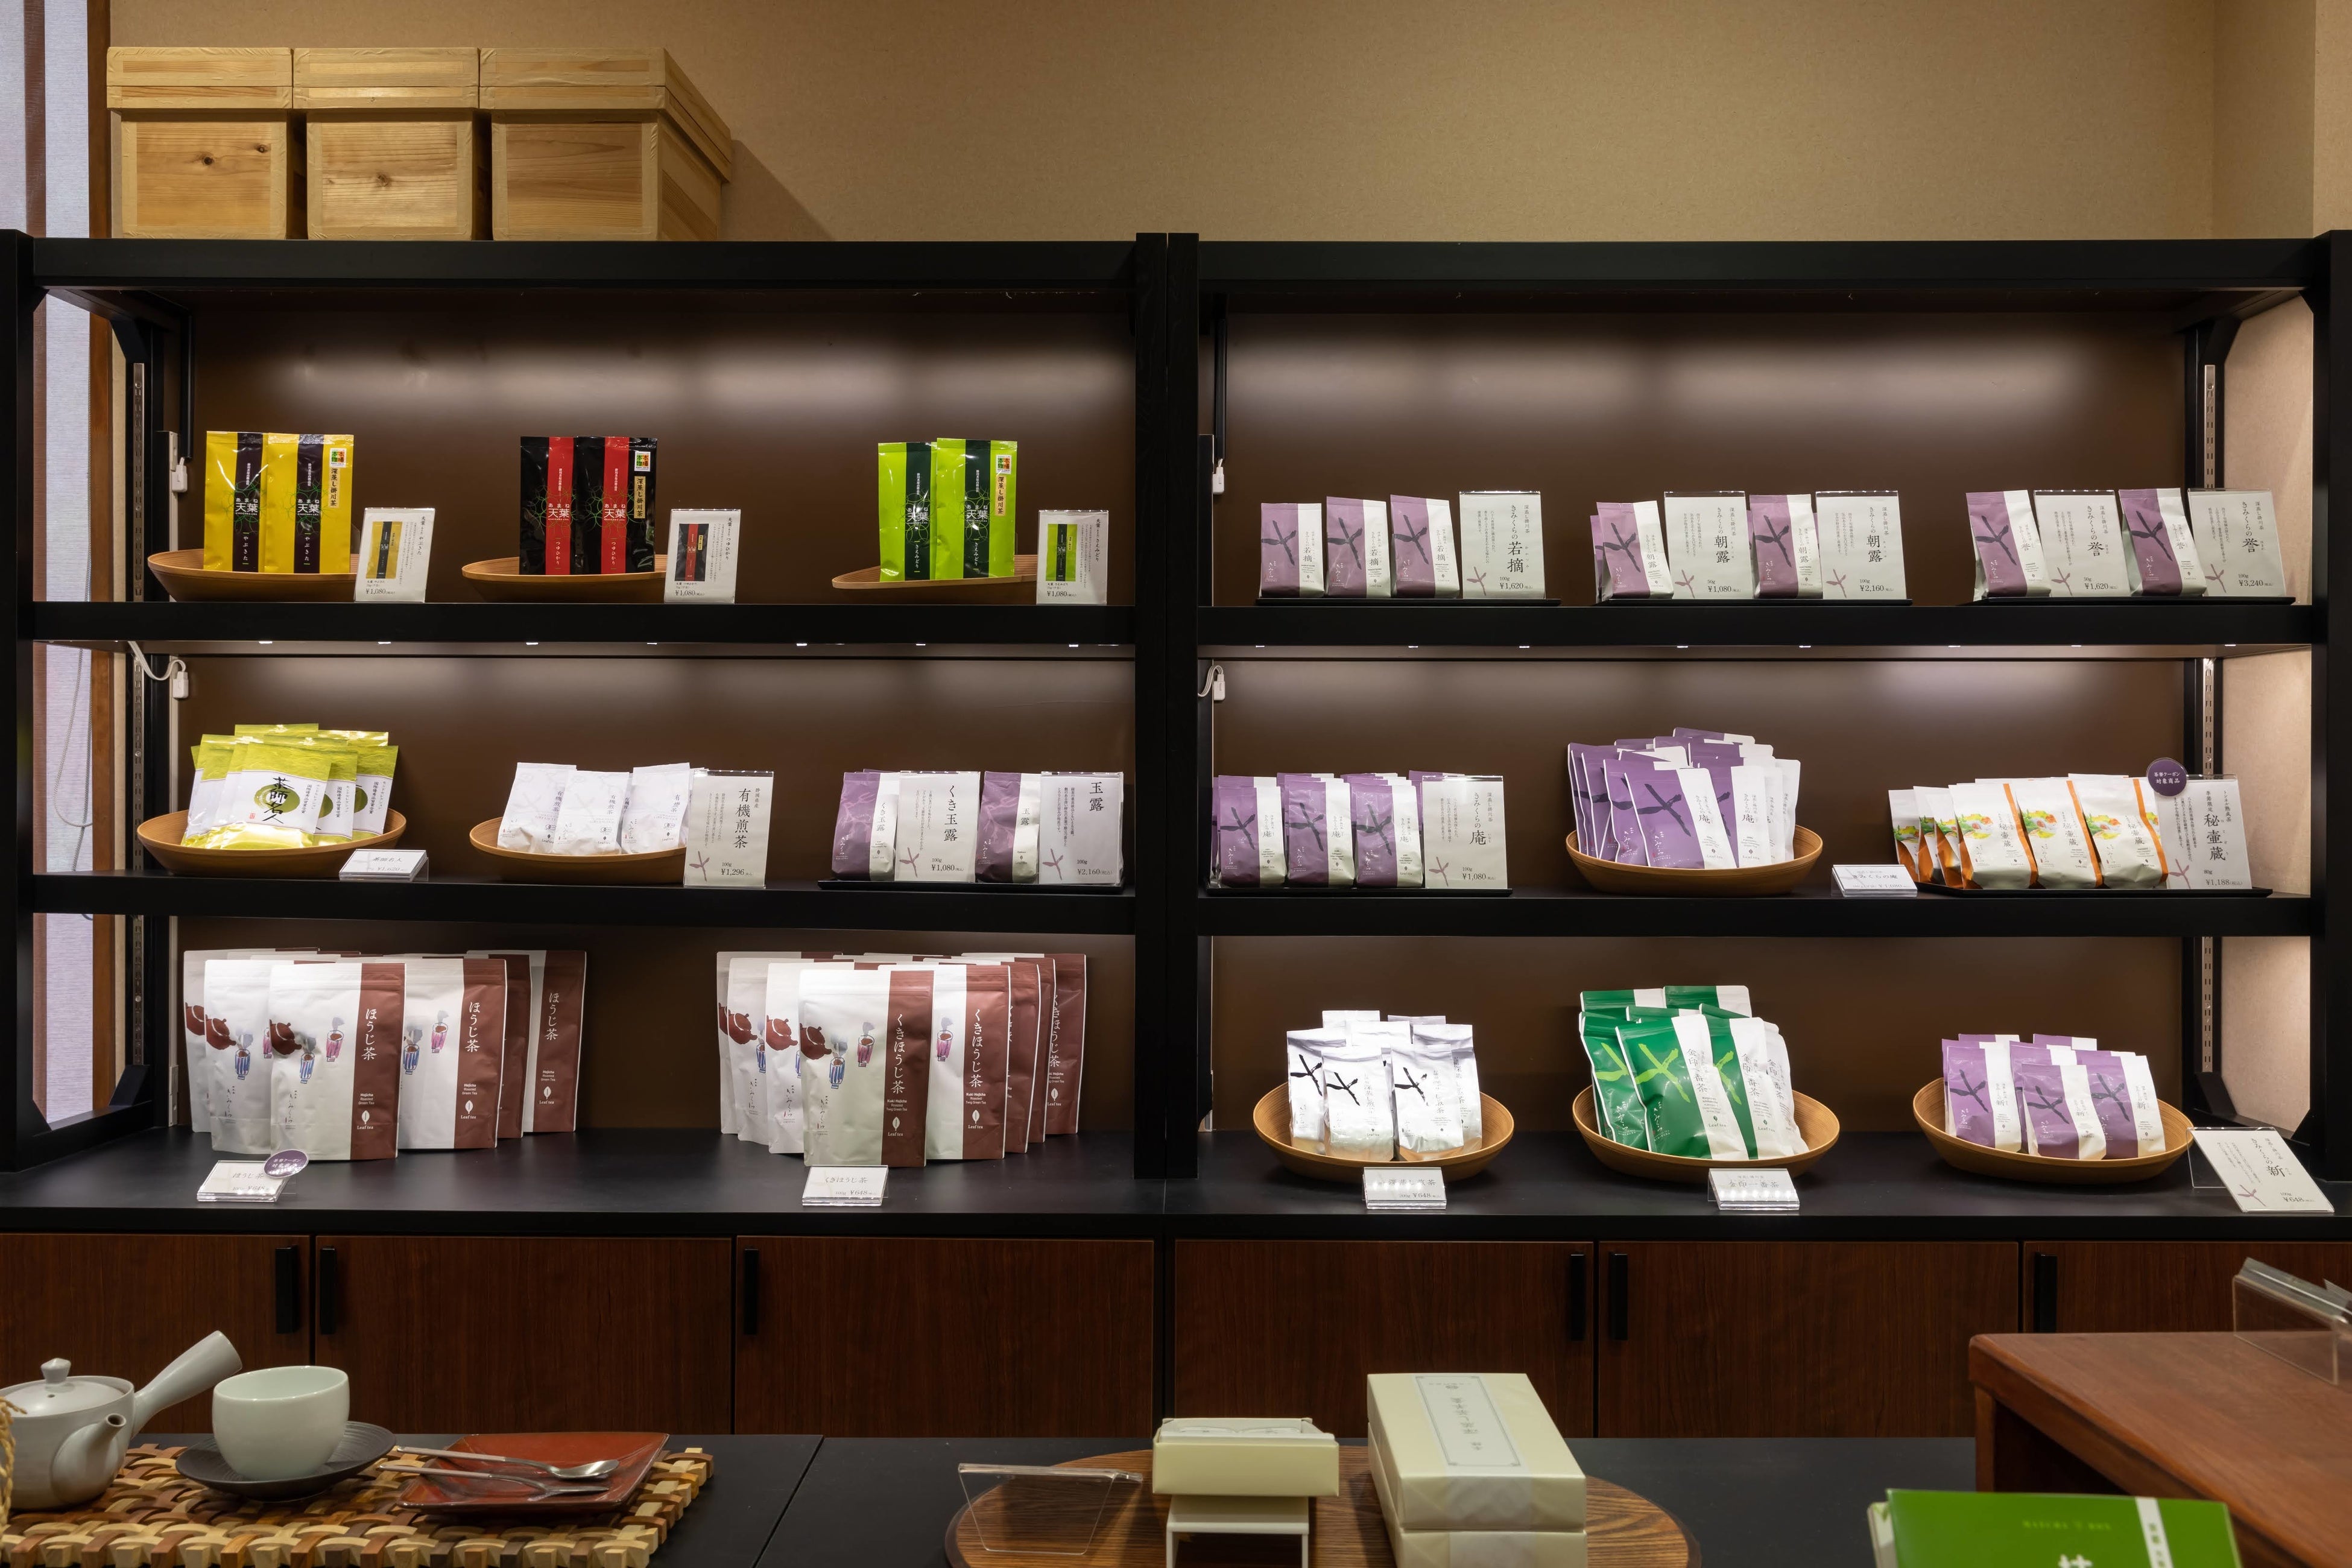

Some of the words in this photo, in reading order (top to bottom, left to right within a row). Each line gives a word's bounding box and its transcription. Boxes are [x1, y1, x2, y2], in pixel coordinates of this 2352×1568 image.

[236, 502, 258, 513] 天葉
[297, 503, 320, 513] 天葉
[548, 508, 570, 519] 天葉
[604, 508, 626, 519] 天葉
[907, 512, 929, 522] 天葉
[966, 510, 988, 520] 天葉
[2087, 506, 2104, 556] きみくらの誉
[2100, 506, 2108, 534] 深蒸し掛川茶
[2242, 502, 2260, 553] きみくらの誉
[2256, 502, 2264, 530] 深蒸し掛川茶
[1507, 505, 1523, 573] きみくらの若摘
[1714, 507, 1730, 563] きみくらの朝露
[1866, 507, 1883, 563] きみくらの朝露
[262, 777, 294, 824] 茶師名人
[733, 788, 751, 849] 有機煎茶
[876, 803, 886, 832] くき玉露
[944, 785, 958, 842] くき玉露
[1020, 808, 1030, 826] 玉露
[1089, 782, 1104, 812] 玉露
[1469, 792, 1486, 845] きみくらの庵
[2204, 814, 2225, 861] 秘壺蔵
[361, 1008, 377, 1061] ほうじ茶
[465, 1002, 480, 1052] ほうじ茶
[545, 993, 559, 1041] ほうじ茶
[1049, 994, 1061, 1067] くきほうじ茶
[890, 1014, 905, 1094] くきほうじ茶
[969, 1009, 984, 1088] くきほうじ茶
[1687, 1048, 1707, 1093] 金印一番茶
